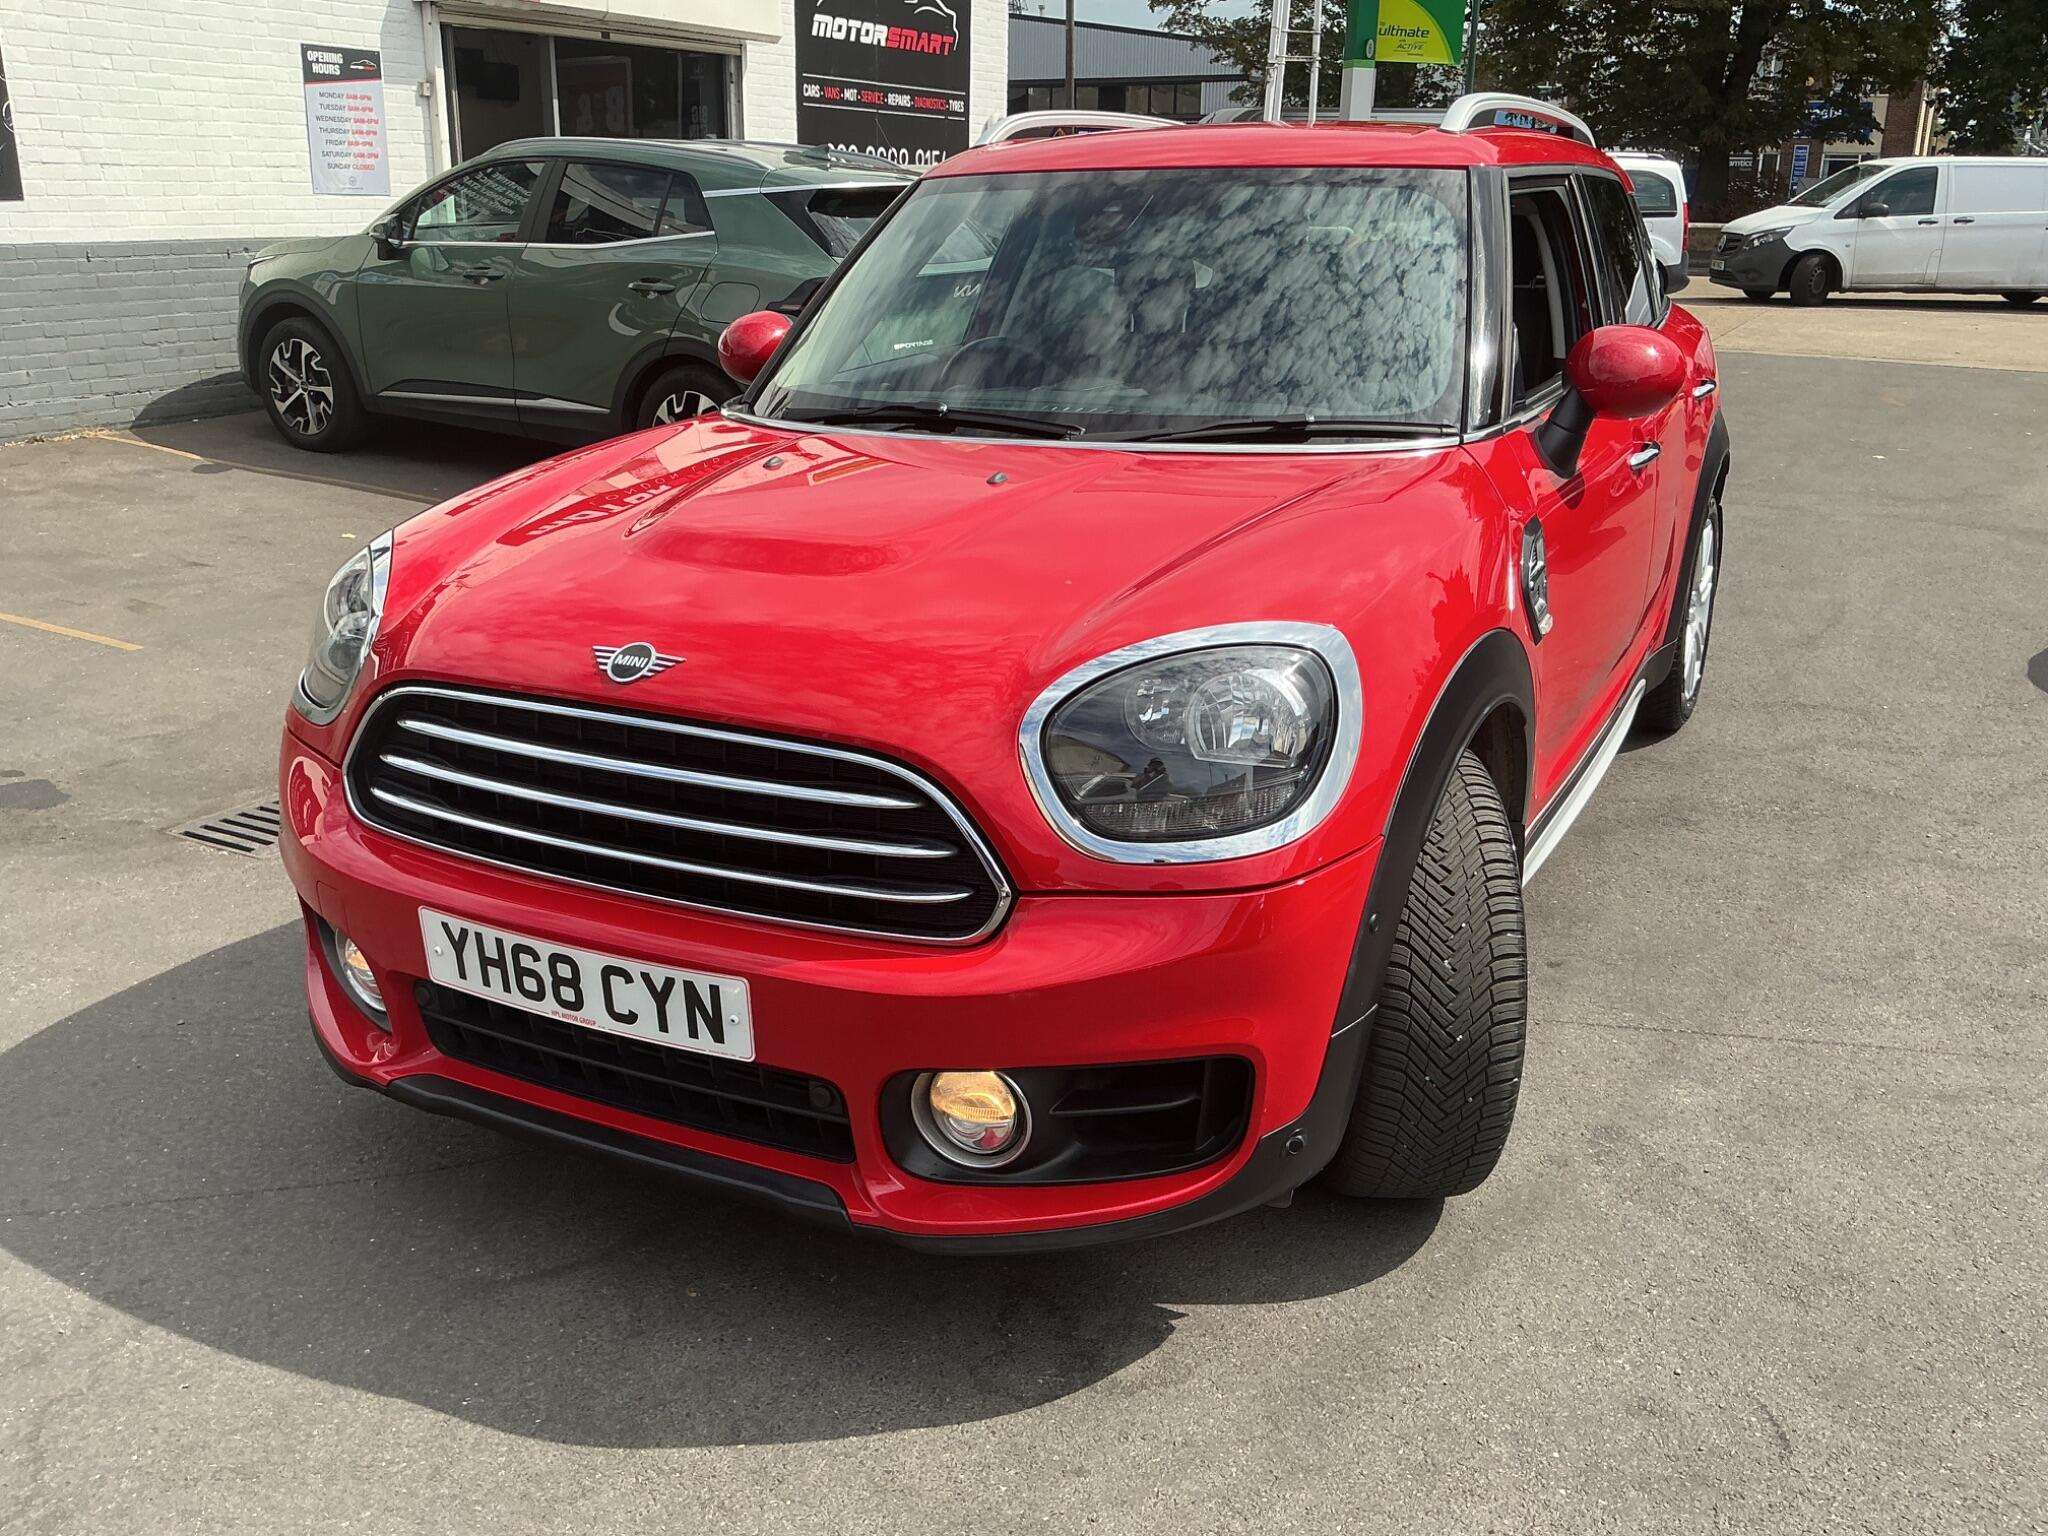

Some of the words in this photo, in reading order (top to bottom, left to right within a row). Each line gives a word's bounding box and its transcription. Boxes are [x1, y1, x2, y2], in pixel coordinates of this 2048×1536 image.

[811, 13, 954, 56] MOTORSMART
[1378, 24, 1430, 38] ultimate
[307, 50, 344, 64] OPENING
[312, 62, 341, 75] HOURS
[319, 91, 344, 99] MONDAY
[803, 84, 820, 97] CARS
[824, 86, 840, 100] VANS
[844, 88, 857, 101] MOT
[861, 90, 884, 105] SERVICE
[887, 92, 911, 107] REPAIRS
[949, 99, 964, 112] TYRES
[320, 103, 346, 111] TUESDAY
[315, 115, 352, 123] WEDNESDAY
[319, 126, 350, 135] THURSDAY
[321, 150, 351, 158] SATURDAY
[327, 162, 350, 170] SUNDAY
[351, 163, 376, 171] CLOSED
[614, 654, 649, 668] MINI
[440, 920, 585, 1013] YH68
[600, 964, 726, 1045] CYN
